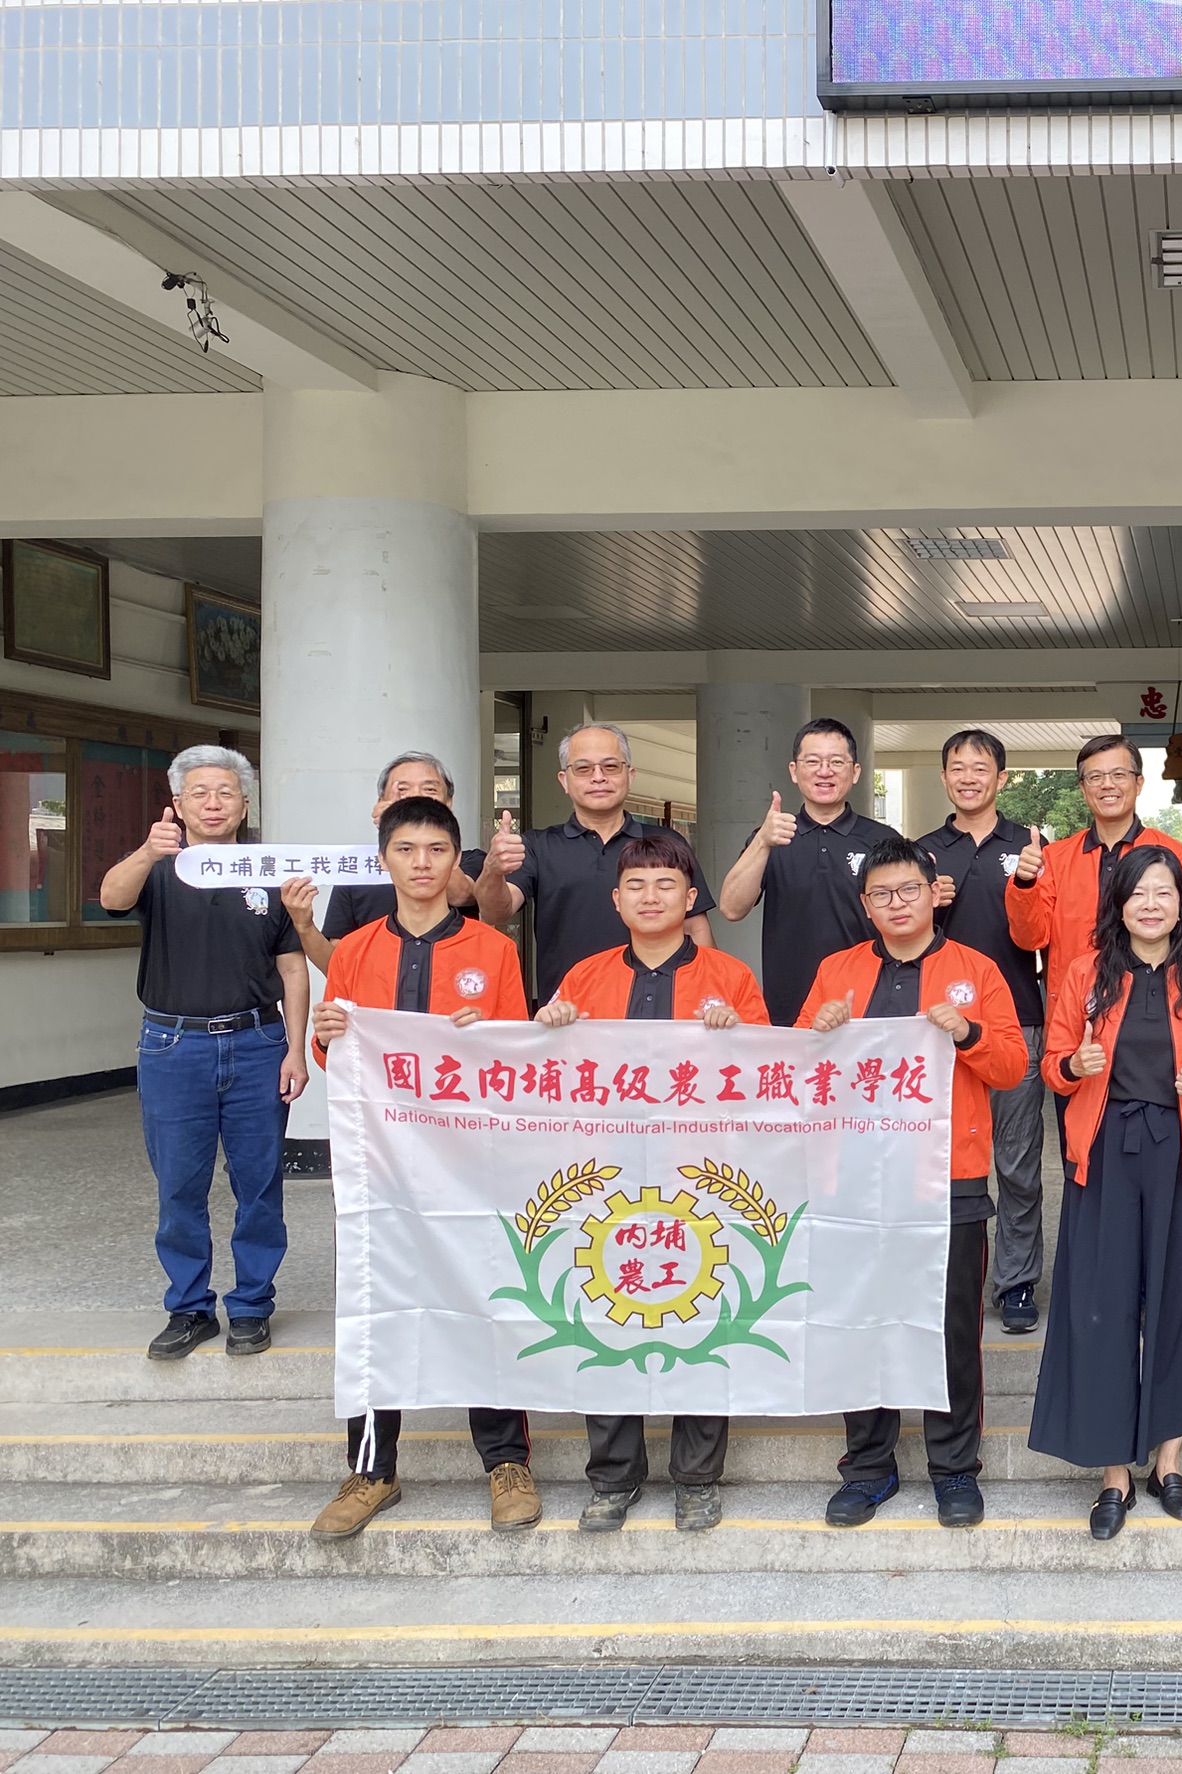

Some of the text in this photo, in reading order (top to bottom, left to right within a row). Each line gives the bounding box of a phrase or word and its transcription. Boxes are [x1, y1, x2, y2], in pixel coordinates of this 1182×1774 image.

[384, 1108, 932, 1137] National Nei-Pu Senior Agricultural-Industrial Vocational High School
[613, 1257, 688, 1295] 農工
